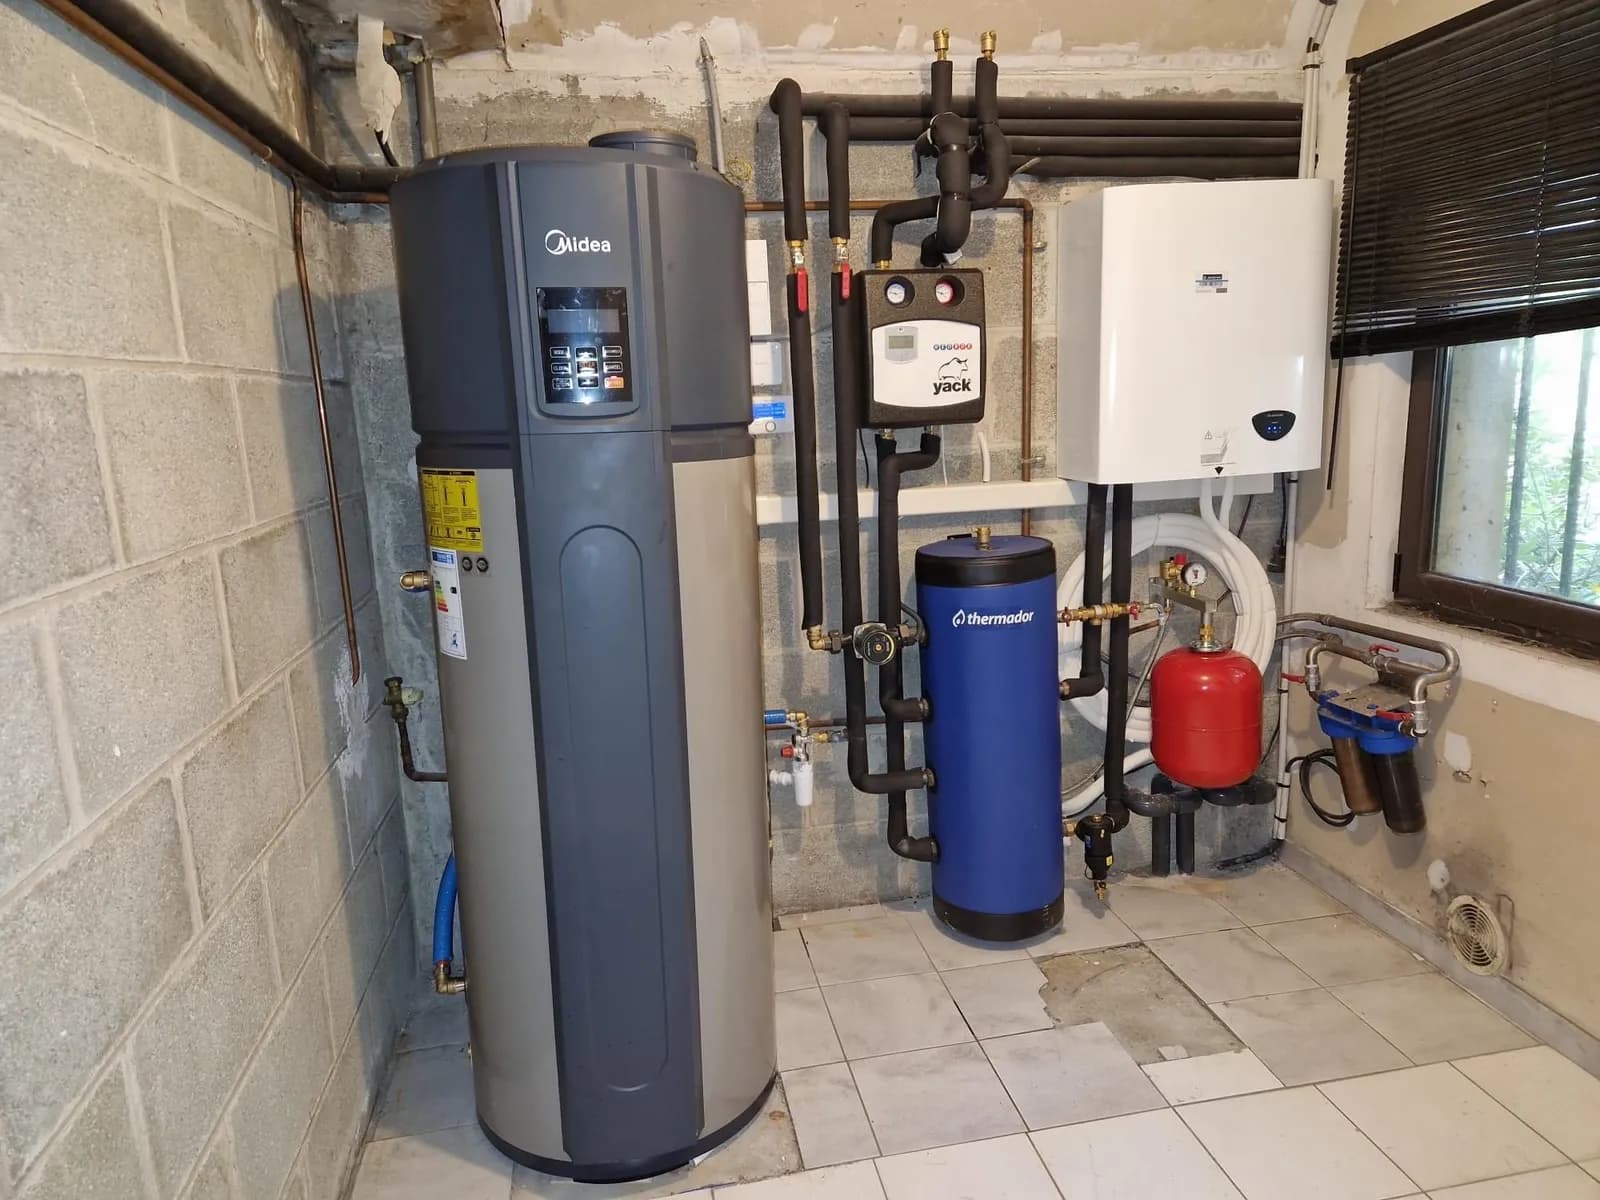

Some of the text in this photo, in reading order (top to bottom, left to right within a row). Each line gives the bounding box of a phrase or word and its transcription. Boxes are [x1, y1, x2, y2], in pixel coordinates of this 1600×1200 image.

[545, 229, 611, 255] Midea
[933, 378, 972, 396] yack
[967, 610, 1034, 625] thermador
